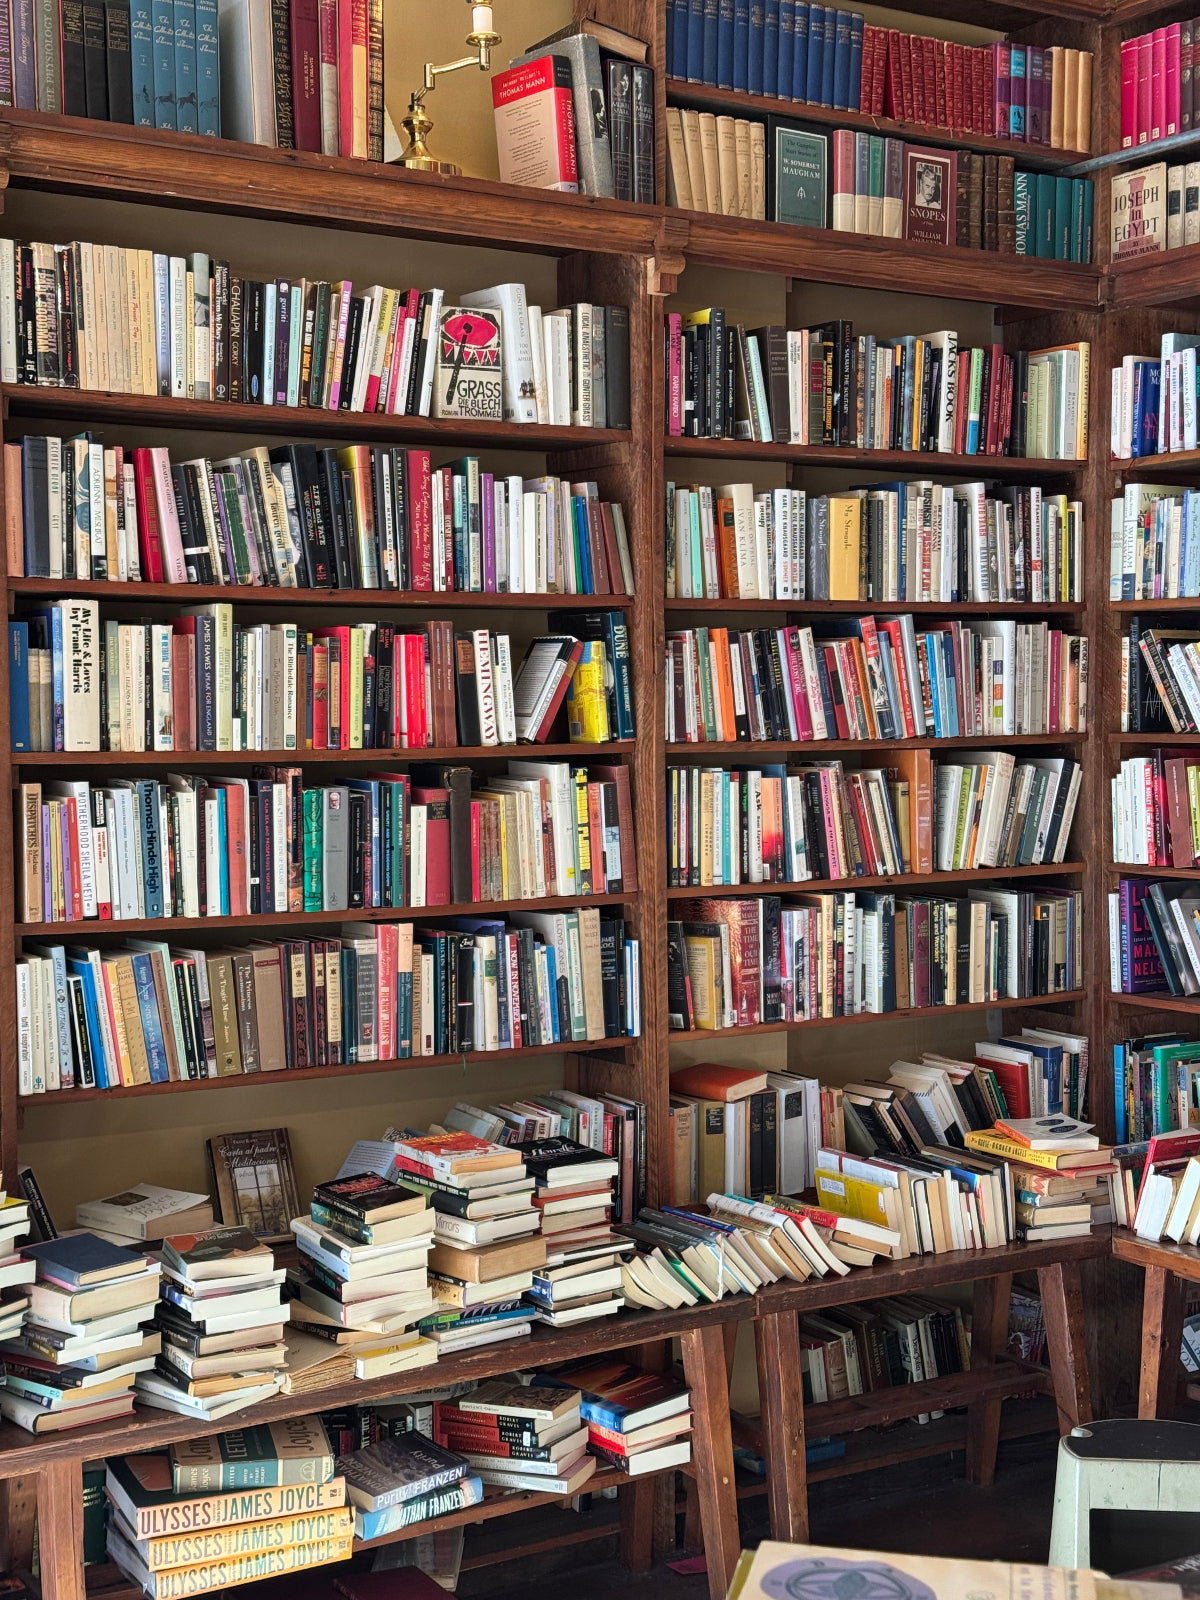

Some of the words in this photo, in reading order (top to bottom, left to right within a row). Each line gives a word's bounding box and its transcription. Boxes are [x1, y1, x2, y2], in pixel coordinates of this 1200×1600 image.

[46, 87, 55, 110] THE
[500, 84, 524, 99] THOMAS
[525, 76, 546, 90] MANN
[566, 99, 575, 140] THOMAS
[569, 144, 577, 175] MANN
[790, 160, 820, 170] SOMERSET
[783, 166, 820, 179] MAUGHAM
[1113, 186, 1159, 213] JOSEPH
[910, 207, 946, 222] SNOPES
[1131, 209, 1142, 221] in
[914, 230, 941, 241] WILLIAM
[1114, 217, 1159, 243] EGYPT
[48, 273, 56, 291] THE
[47, 291, 56, 332] EMPIRE
[280, 297, 288, 323] gorriti
[37, 302, 48, 353] GOODMAN
[582, 312, 590, 334] LOCAL
[47, 332, 57, 355] CITY
[582, 335, 590, 371] ANAESTHETIC
[457, 379, 501, 399] GRASS
[458, 398, 469, 407] DIE
[470, 398, 501, 410] BLECH
[583, 401, 591, 422] GRASS
[162, 460, 170, 487] GRAHAM
[263, 461, 272, 489] matrix
[165, 489, 174, 516] GREENE
[819, 504, 827, 516] My
[844, 505, 853, 517] My
[923, 488, 932, 527] KOSINSKI
[271, 502, 280, 528] lauren
[312, 485, 321, 506] LIFE
[318, 526, 326, 546] FATE
[274, 530, 283, 549] groff
[819, 520, 827, 550] Struggle
[844, 520, 853, 550] Struggle
[923, 531, 931, 569] PASSION
[923, 572, 931, 591] PLAY
[70, 607, 82, 621] by
[81, 607, 92, 625] My
[72, 623, 82, 656] Frank
[83, 628, 92, 648] Life
[203, 620, 211, 643] JAMES
[614, 625, 626, 659] DUNE
[83, 651, 92, 660] &
[73, 659, 82, 694] Harris
[83, 662, 92, 694] Loves
[792, 664, 800, 680] LOST
[478, 632, 495, 740] HEMINGWAY
[794, 681, 802, 695] GIRL
[144, 782, 156, 829] Thomas
[960, 787, 968, 807] LITTLE
[26, 793, 39, 848] DISPATCHES
[80, 792, 90, 849] MOTHERHOOD
[147, 831, 157, 866] Hinde
[954, 828, 962, 855] HUMAN
[81, 851, 91, 880] SHEILA
[146, 866, 160, 894] High
[84, 882, 93, 903] HETI
[556, 920, 564, 944] LLOYD
[743, 935, 758, 943] TIME
[745, 927, 757, 935] THE
[558, 946, 566, 974] JONES
[743, 959, 758, 967] TIME
[744, 950, 758, 958] OUR
[511, 970, 519, 980] IN
[219, 980, 228, 1002] Tragic
[381, 990, 390, 1015] HENRY
[511, 981, 520, 1023] NOVEMBER
[110, 983, 120, 1016] ALICE
[116, 1021, 127, 1057] JAMES
[381, 1020, 390, 1043] JAMES
[218, 1145, 243, 1157] Carta
[245, 1144, 254, 1155] al
[253, 1142, 279, 1158] padre,
[977, 1138, 990, 1149] HOUSE
[991, 1142, 1012, 1153] BROKEN
[1012, 1145, 1027, 1158] ANGELS
[224, 1156, 278, 1169] Meditaciones
[123, 1194, 172, 1216] James
[137, 1201, 179, 1218] Joyce
[435, 1215, 460, 1234] Mirrors
[282, 1420, 320, 1451] Joyce
[188, 1467, 198, 1491] James
[200, 1467, 210, 1491] Joyce
[414, 1467, 463, 1494] FRANZEN
[140, 1501, 212, 1535] ULYSSES
[222, 1492, 273, 1522] JAMES
[278, 1484, 325, 1512] JOYCE
[428, 1488, 466, 1518] FRANZEN
[152, 1532, 223, 1567] ULYSSES
[233, 1523, 284, 1553] JAMES
[289, 1513, 335, 1542] JOYCE
[160, 1562, 228, 1599] ULYSSES
[238, 1549, 285, 1581] JAMES
[290, 1541, 335, 1568] JOYCE
